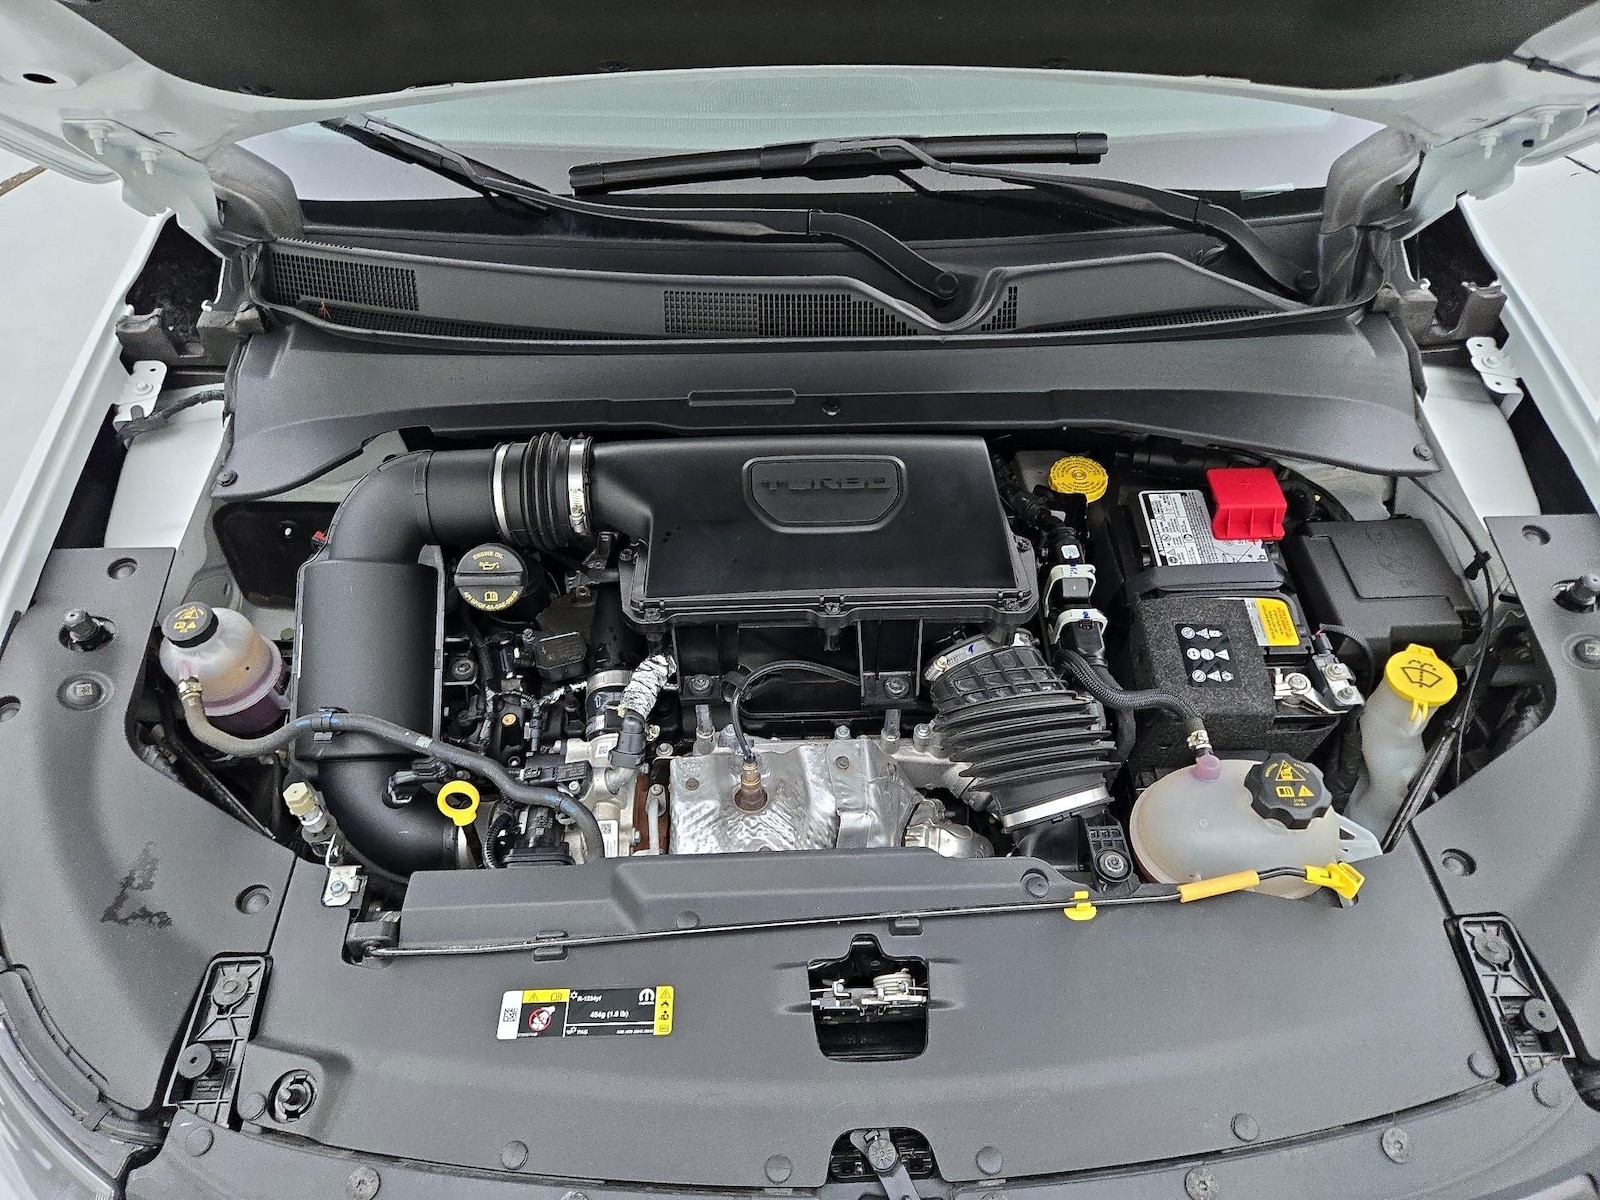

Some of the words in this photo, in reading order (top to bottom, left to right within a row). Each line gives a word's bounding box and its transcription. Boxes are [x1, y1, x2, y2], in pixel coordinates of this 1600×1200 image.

[759, 476, 892, 492] TURBO
[472, 551, 494, 561] ENGINE
[494, 551, 504, 560] OIL
